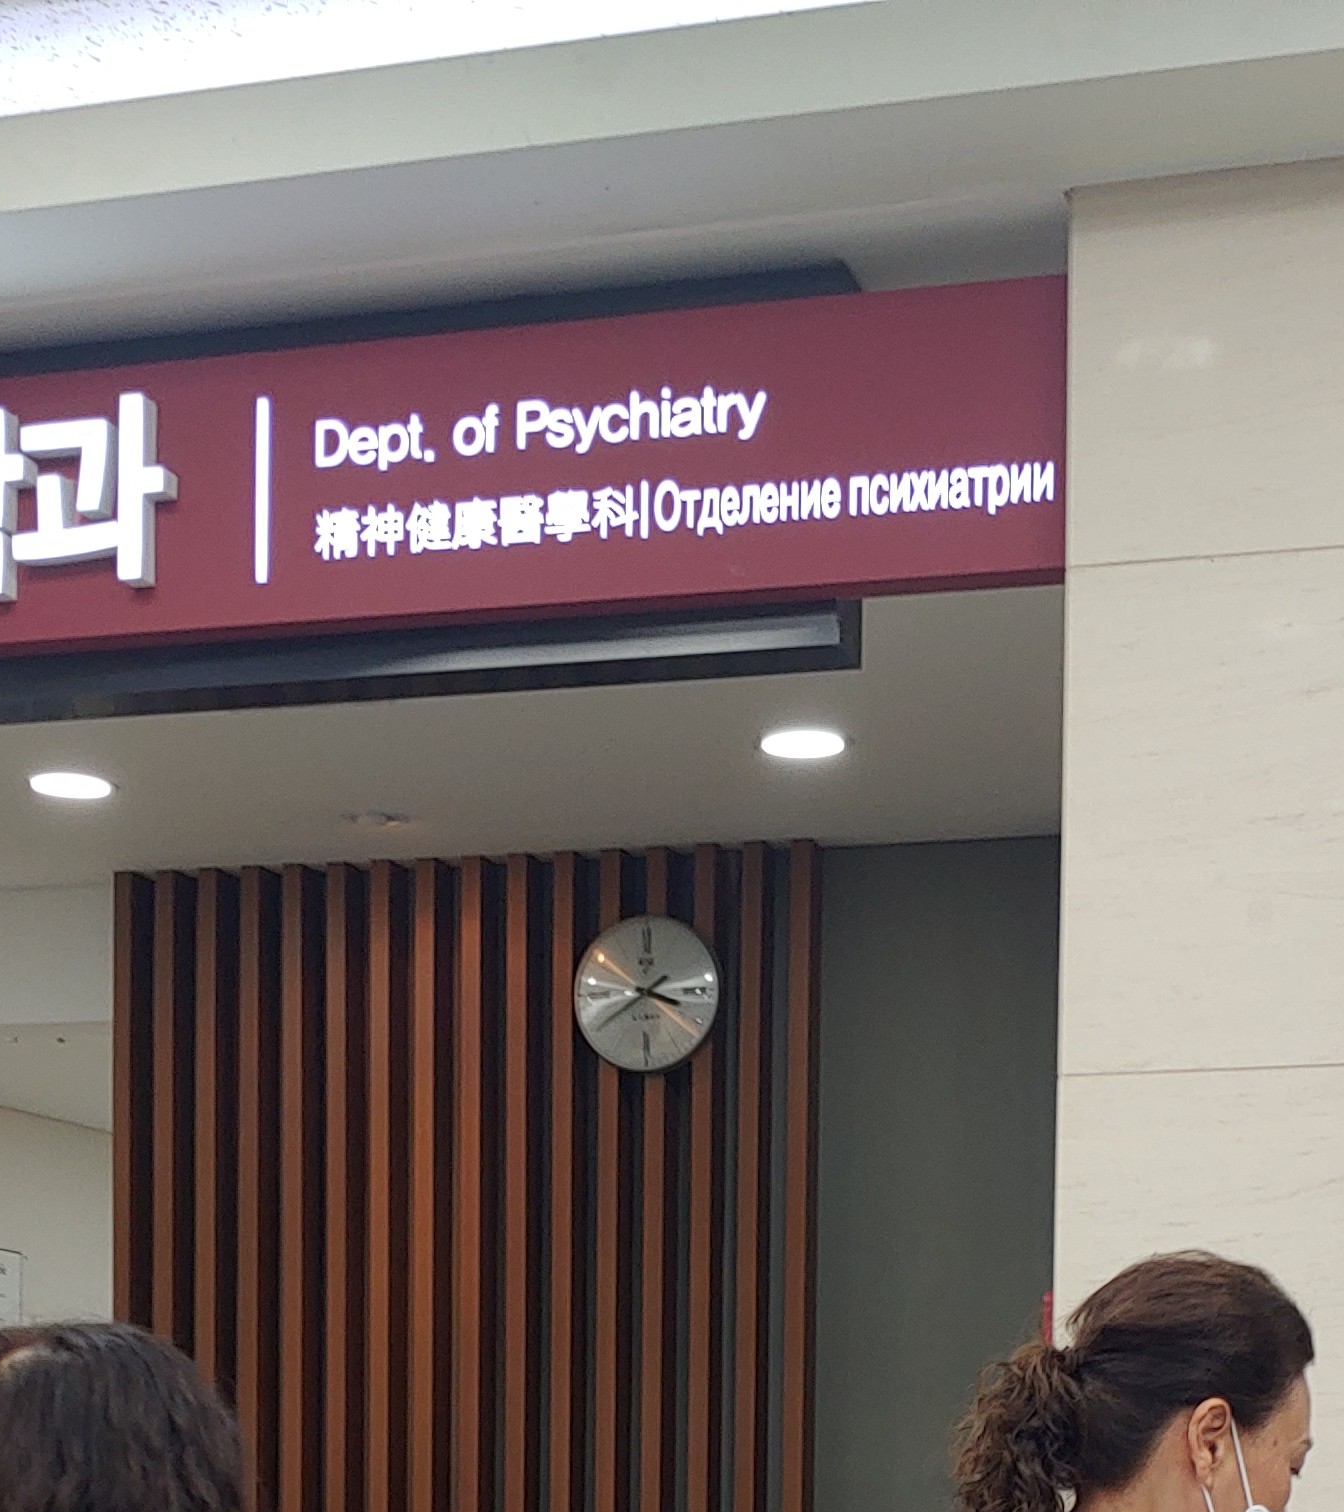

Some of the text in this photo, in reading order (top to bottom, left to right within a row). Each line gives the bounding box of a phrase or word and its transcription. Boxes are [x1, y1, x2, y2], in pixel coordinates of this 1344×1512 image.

[313, 386, 767, 471] Dept. of Psychiatry
[653, 460, 1055, 535] Отделение психиатрии
